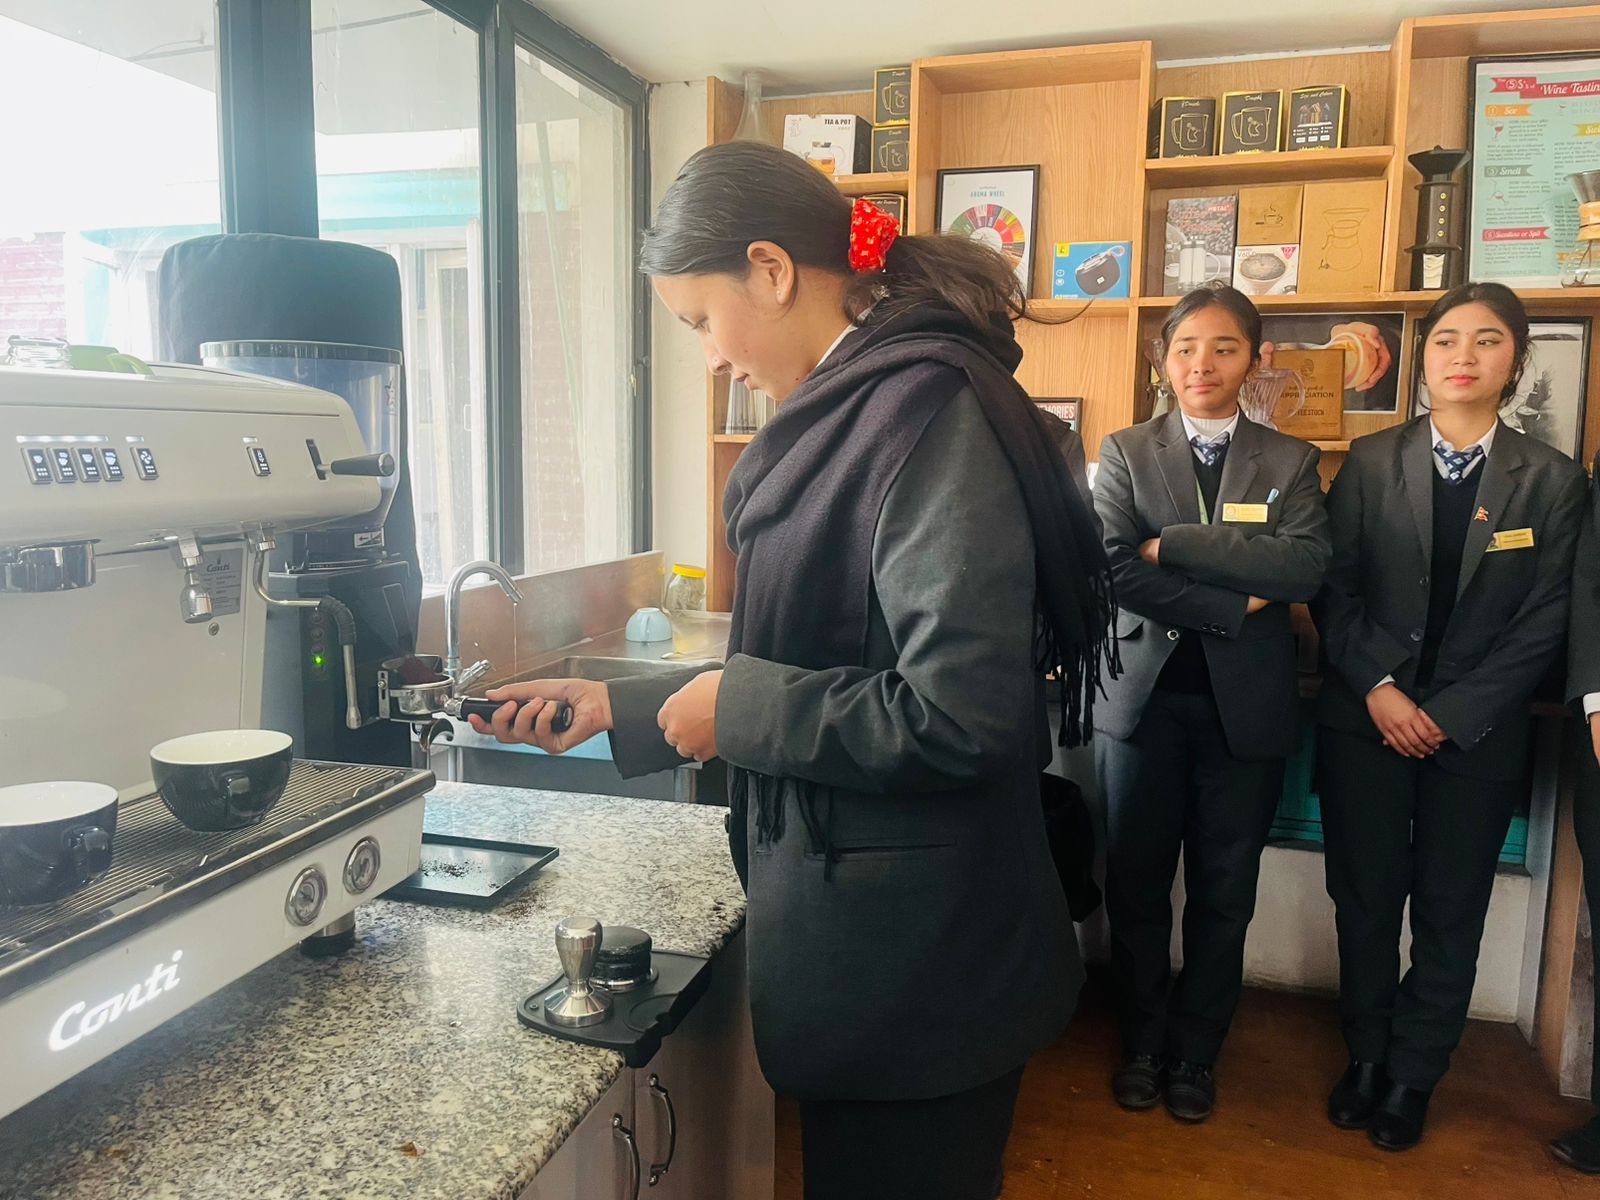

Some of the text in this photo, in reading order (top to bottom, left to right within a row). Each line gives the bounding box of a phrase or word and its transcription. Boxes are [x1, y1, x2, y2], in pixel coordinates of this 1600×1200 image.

[1541, 84, 1567, 95] Wine
[1500, 167, 1521, 176] Smell
[48, 949, 183, 1052] Conti
